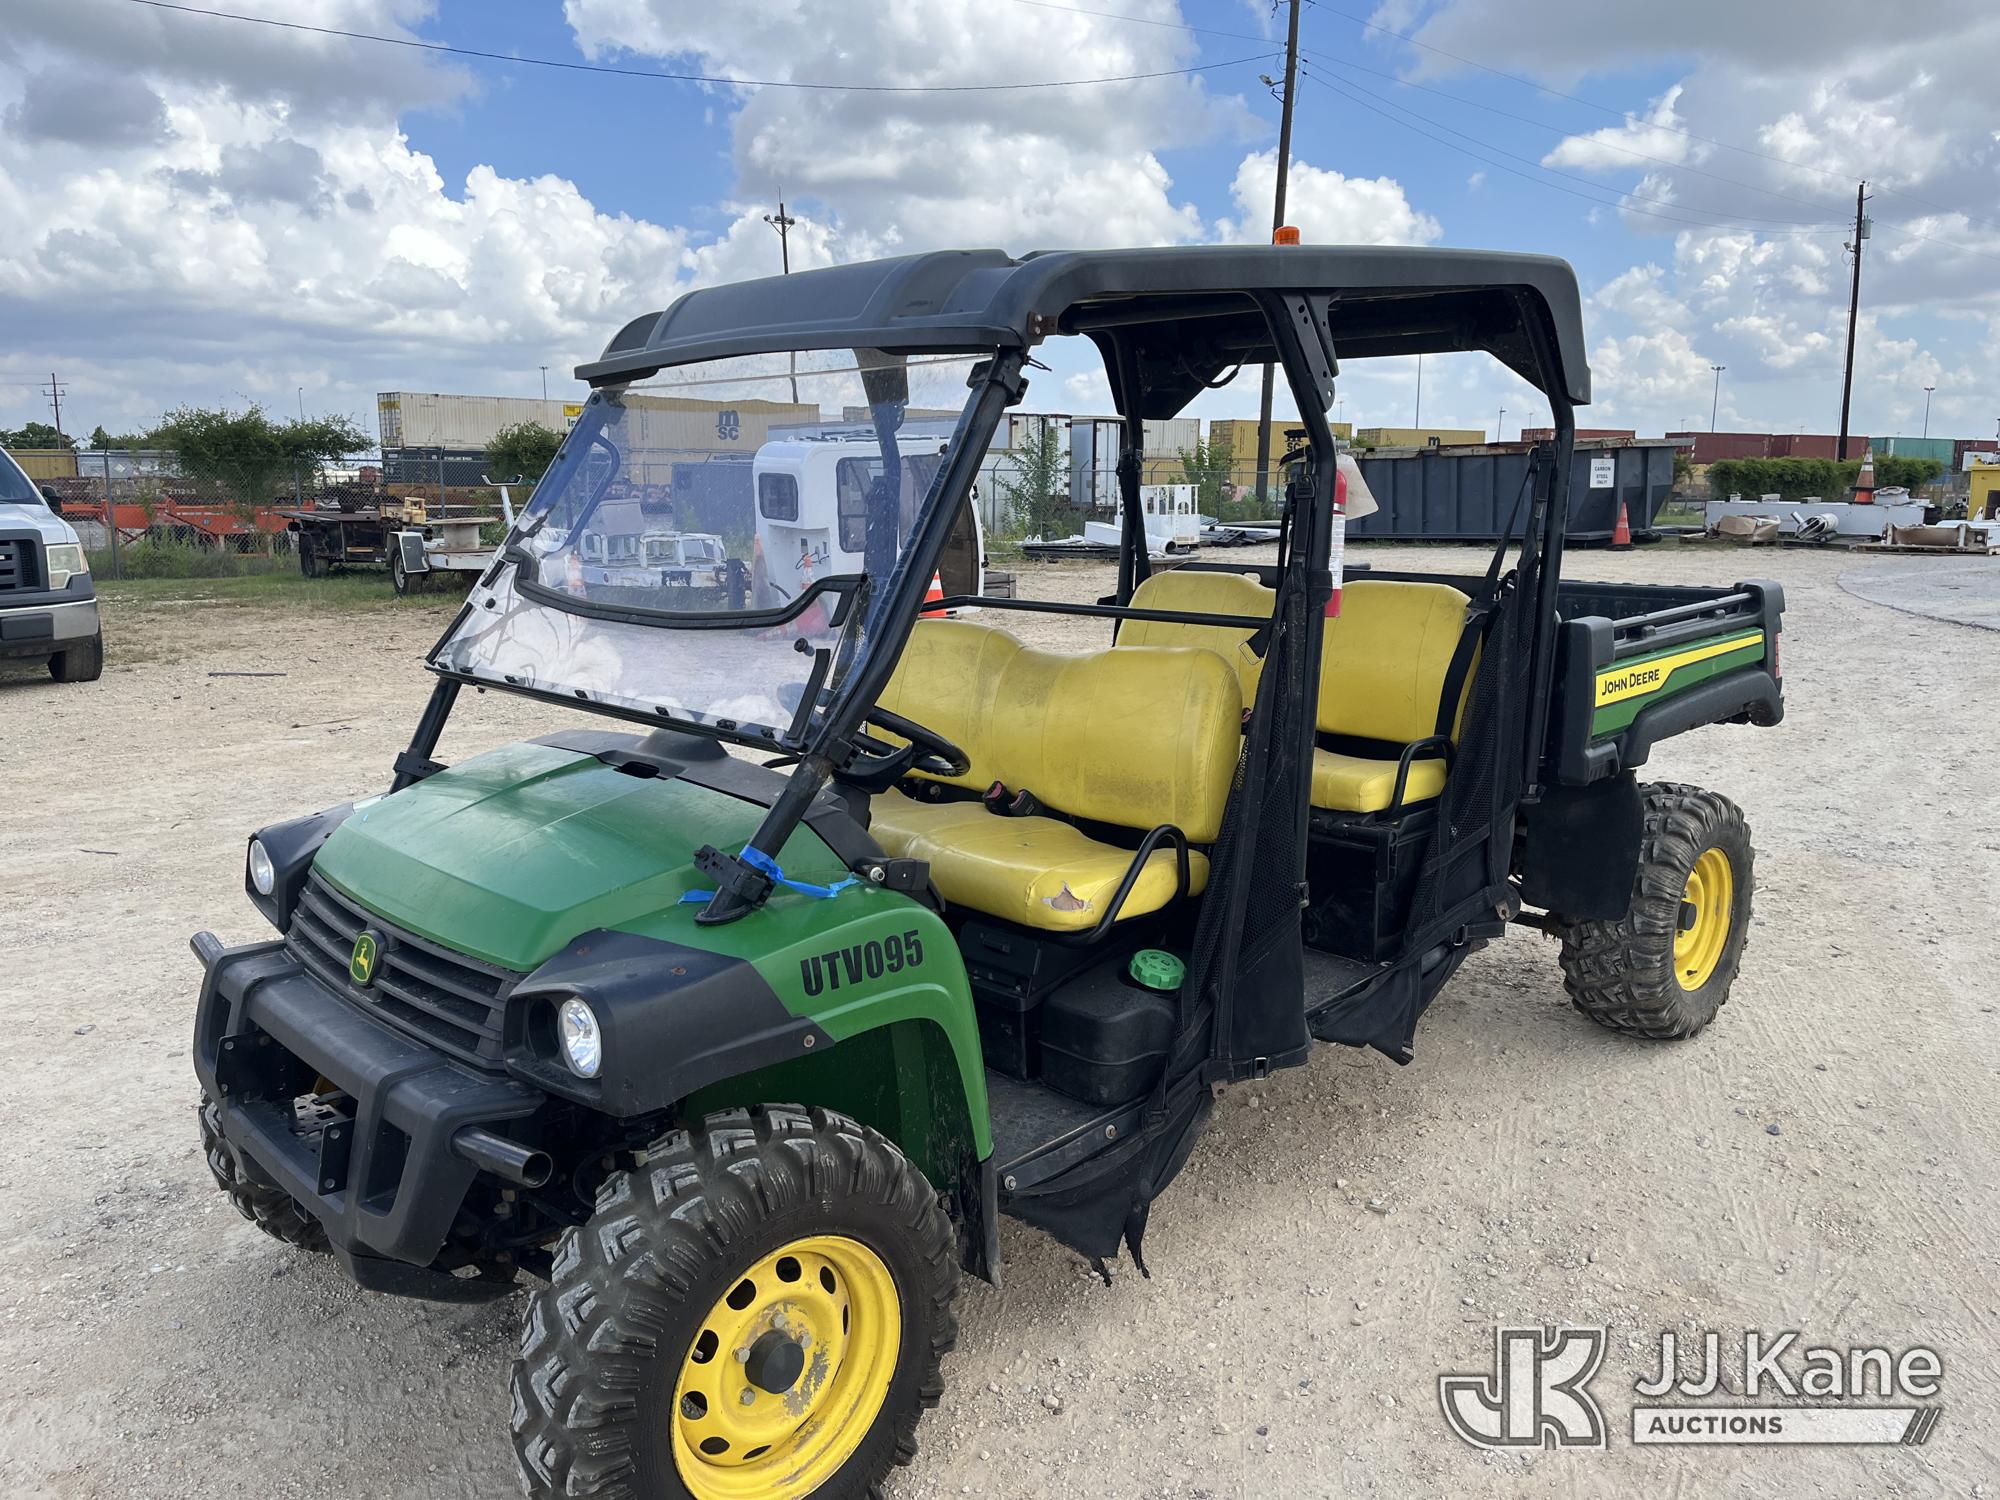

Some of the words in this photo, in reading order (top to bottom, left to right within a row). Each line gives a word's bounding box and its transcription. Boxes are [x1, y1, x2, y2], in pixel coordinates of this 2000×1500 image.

[1602, 677, 1627, 696] JOHN
[1629, 668, 1660, 688] DEERE
[800, 929, 923, 996] UTV095
